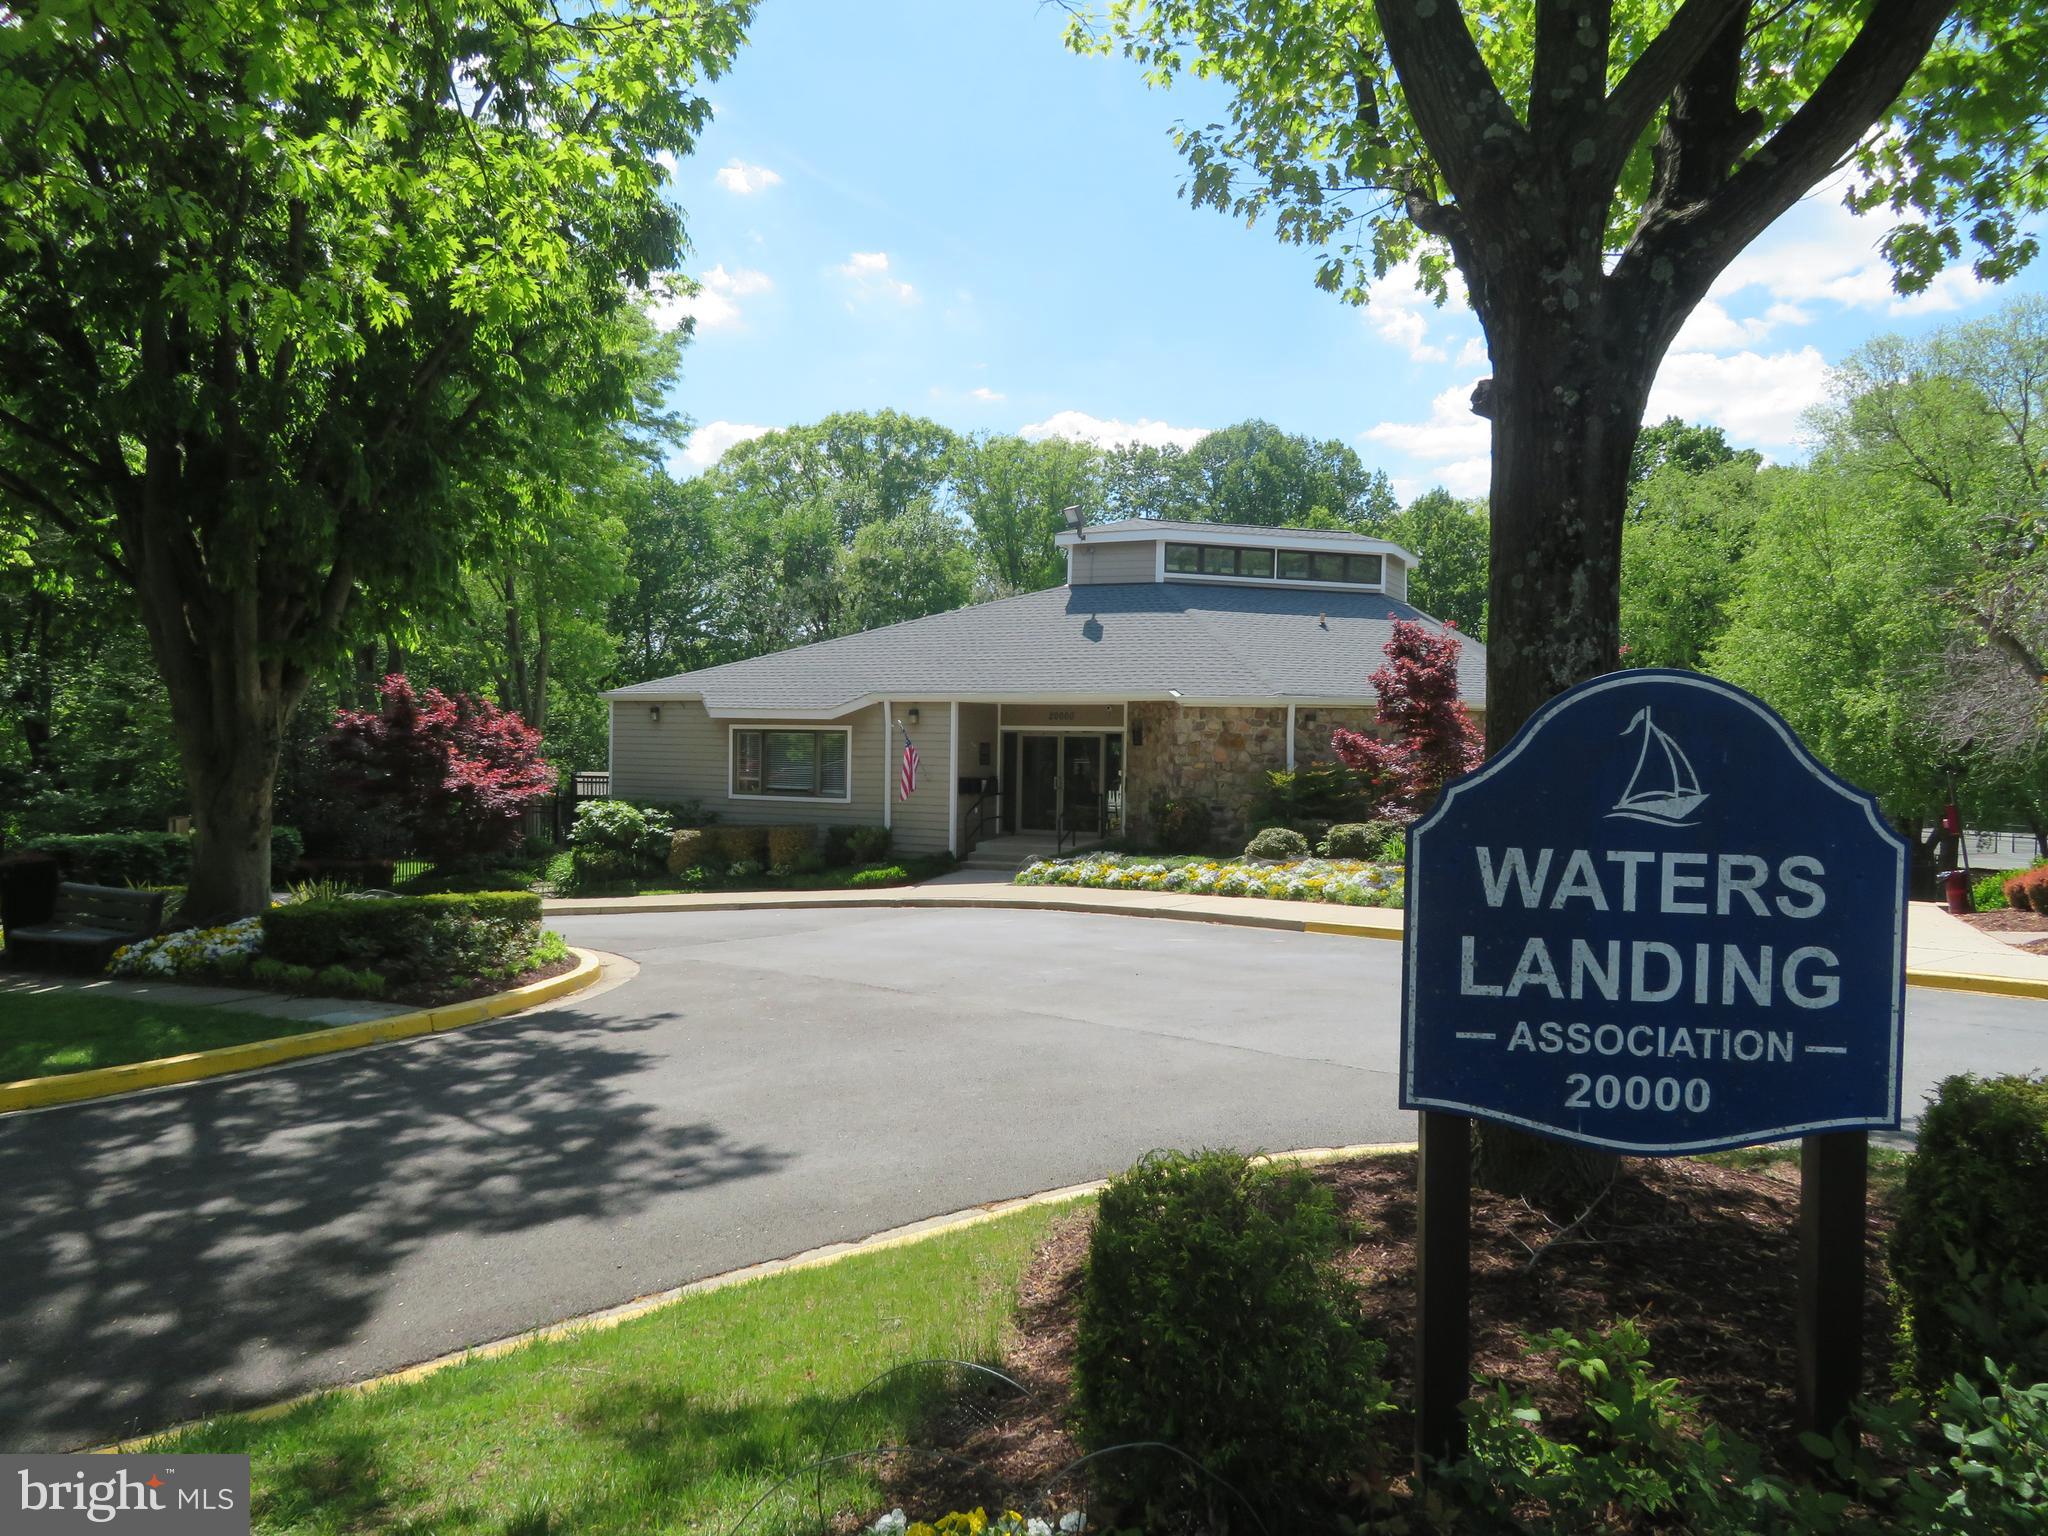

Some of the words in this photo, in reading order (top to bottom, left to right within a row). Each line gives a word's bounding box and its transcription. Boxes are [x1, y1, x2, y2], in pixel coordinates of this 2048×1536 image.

[1475, 846, 1826, 919] WATERS
[1460, 935, 1841, 1009] LANDING
[1507, 1021, 1793, 1062] ASSOCIATION
[1564, 1073, 1711, 1113] 20000
